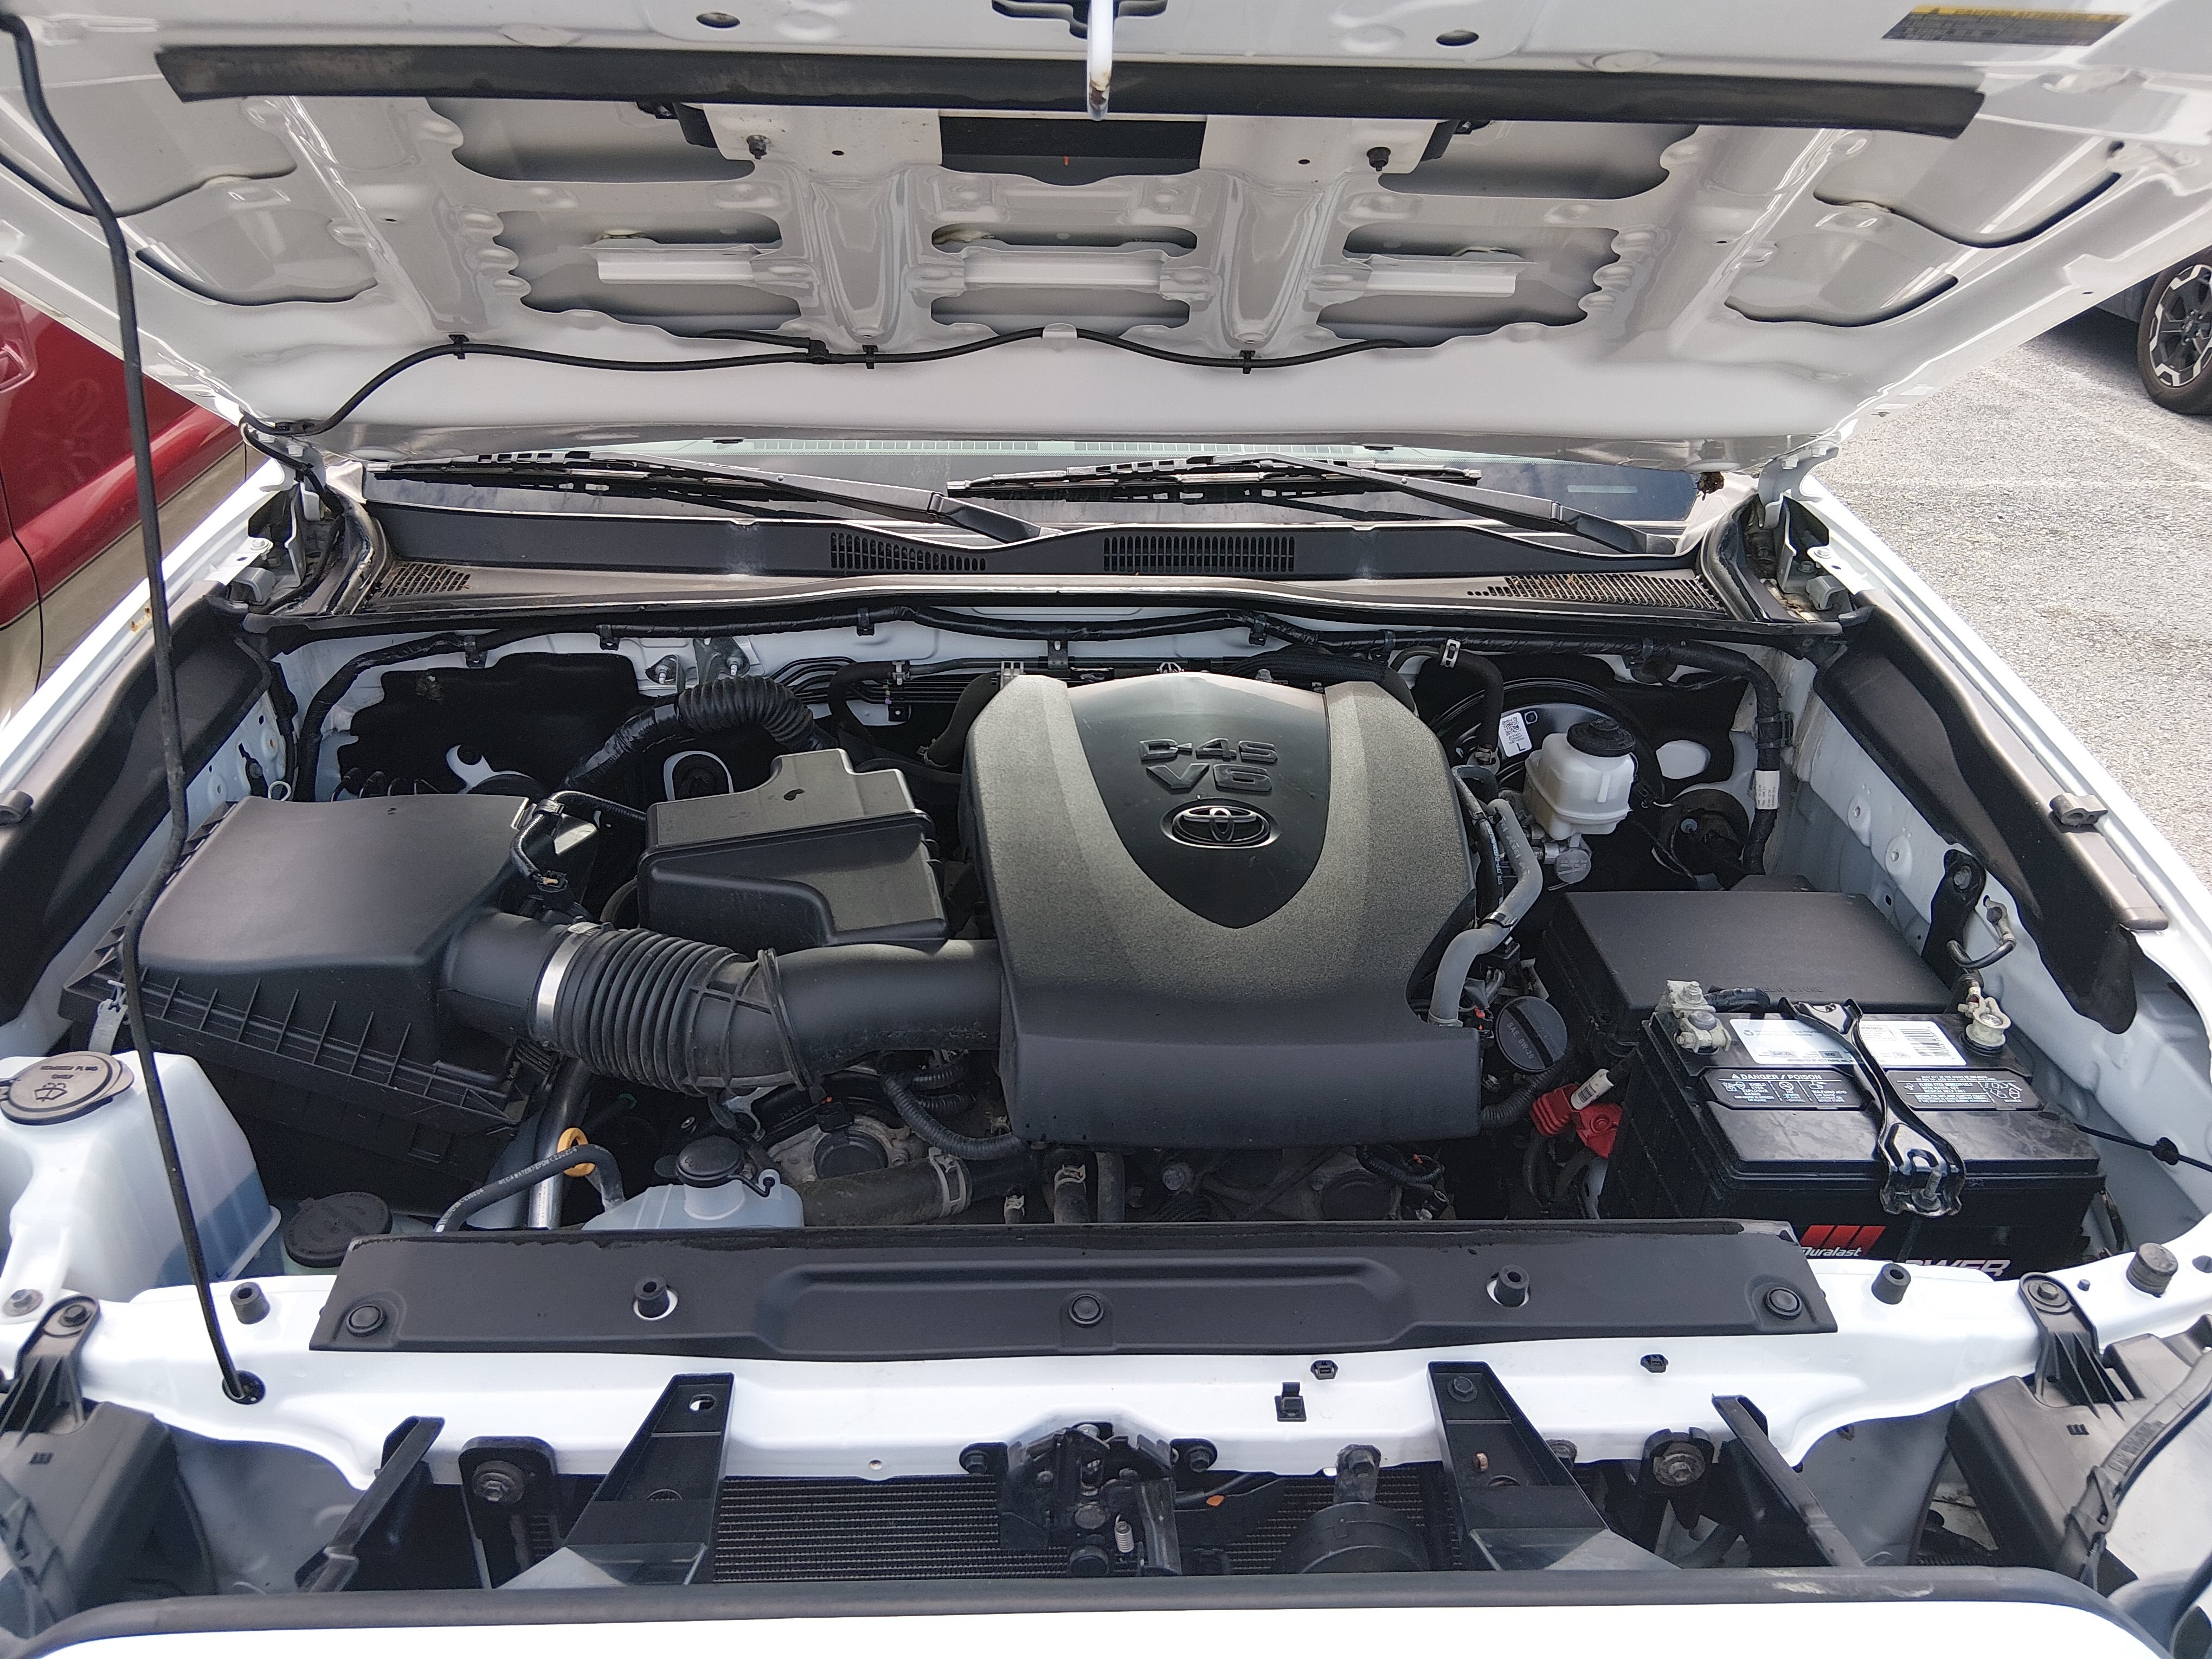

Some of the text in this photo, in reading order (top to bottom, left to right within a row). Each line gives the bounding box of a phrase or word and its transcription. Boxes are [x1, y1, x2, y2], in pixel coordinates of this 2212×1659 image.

[1140, 737, 1278, 763] D-4S
[1516, 743, 1526, 751] L
[1146, 763, 1272, 793] V6
[1507, 1022, 1534, 1059] SAE 0W-20
[1801, 1246, 1862, 1257] Duralast
